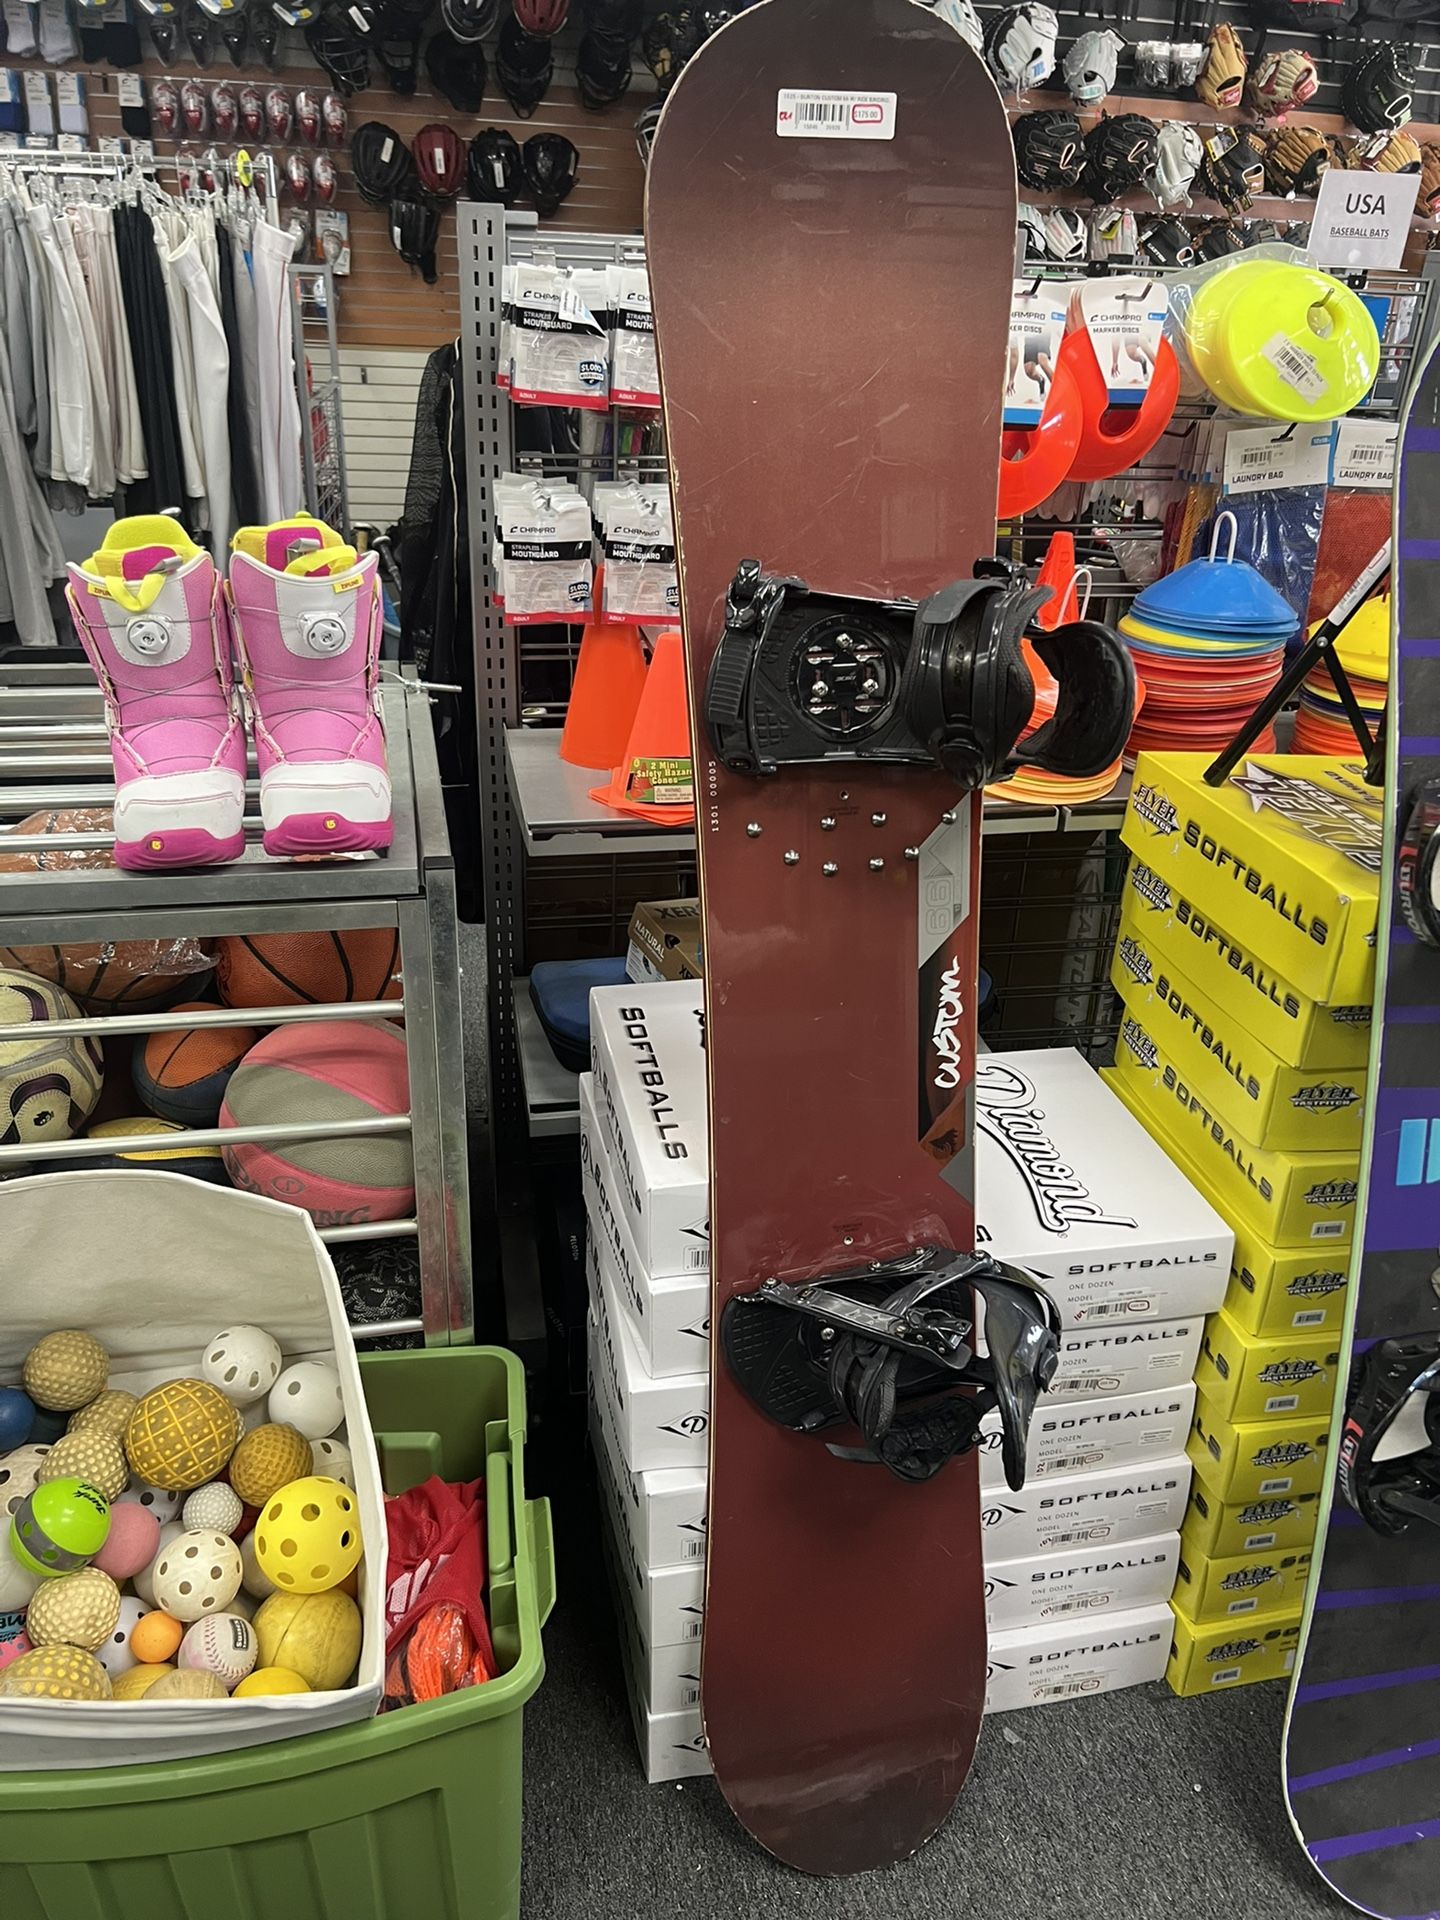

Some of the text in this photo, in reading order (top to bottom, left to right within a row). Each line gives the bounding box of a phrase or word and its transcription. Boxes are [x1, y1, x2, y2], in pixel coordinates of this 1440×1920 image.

[1345, 193, 1385, 215] USA
[1330, 227, 1389, 238] BASEBALL BATS
[1146, 243, 1167, 263] EASTON
[523, 311, 552, 320] STRAPLESS
[1011, 312, 1046, 321] HAMPRO
[1100, 314, 1142, 322] CHAMPRO
[523, 318, 573, 330] MOUTHGUARD
[626, 320, 654, 329] MOUTH
[1024, 325, 1043, 334] DISCS
[1121, 326, 1140, 334] DISCS
[581, 363, 602, 372] $1,000
[519, 392, 537, 400] ADULT
[1232, 471, 1284, 484] LAUNDRY BAG
[1339, 471, 1393, 480] LAUNDRY BAG
[520, 526, 556, 534] CHAMPRO
[623, 527, 660, 537] CHAMPRO
[511, 550, 560, 559] MOUTHGUARD
[613, 544, 643, 552] STRAPLESS
[612, 550, 661, 560] MOUTHGUARD
[570, 583, 589, 593] $1,000
[659, 761, 679, 769] Mini
[636, 768, 692, 779] Safety Hazar
[651, 777, 678, 785] Cones
[708, 760, 720, 832] 1301 00005
[1136, 783, 1177, 821] FLYER
[1133, 801, 1171, 834] FASTPITCH
[1134, 863, 1172, 900] FLYER
[1182, 819, 1329, 946] SOFTBALLS
[1132, 878, 1166, 910] FASTPITCH
[654, 905, 700, 919] XER
[634, 919, 665, 960] NATURAL
[1122, 934, 1153, 971] FLYER
[1174, 899, 1300, 1020] SOFTBALLS
[1119, 950, 1148, 985] FASTPITCH
[932, 955, 964, 1089] CUSTOM
[1126, 1017, 1158, 1060] FLYER
[1155, 974, 1261, 1101] SOFTBALLS
[1122, 1031, 1153, 1070] FASTPITCH
[619, 1006, 689, 1160] SOFTBALLS
[1299, 1085, 1354, 1101] FLYER
[1291, 1098, 1351, 1108] FASTPITCH
[1161, 1067, 1274, 1202] SOFTBALLS
[603, 1071, 643, 1215] SOFTBALLS
[594, 1163, 644, 1317] SOFTBALLS
[1068, 1253, 1218, 1276] SOFTBALLS
[1068, 1280, 1115, 1291] ONE DOZEN
[1293, 1272, 1346, 1288] FLYER
[1287, 1283, 1342, 1296] FASTPITCH
[1067, 1295, 1093, 1303] MODEL
[593, 1246, 625, 1410] SOFTBALLS
[1056, 1328, 1190, 1353] OFTBALLS
[1062, 1358, 1088, 1367] DOZEN
[1264, 1359, 1317, 1375] FLYER
[1259, 1373, 1314, 1384] FASTPITCH
[1042, 1403, 1181, 1432] SOFTBALLS
[1040, 1434, 1082, 1446] ONE DOZEN
[1038, 1449, 1063, 1457] MODEL
[1259, 1442, 1308, 1458] FLYER
[1251, 1453, 1305, 1466] FASTPITCH
[1040, 1480, 1177, 1509] SOFTBALLS
[1242, 1500, 1291, 1516] FLYER
[1037, 1511, 1079, 1522] ONE DOZEN
[1238, 1512, 1288, 1525] FASTPITCH
[1036, 1525, 1060, 1533] MODEL
[1031, 1554, 1167, 1582] SOFTBALLS
[1224, 1566, 1273, 1583] FLYER
[1220, 1576, 1271, 1590] FASTPITCH
[1031, 1584, 1074, 1596] ONE DOZEN
[1031, 1598, 1054, 1606] MODEL
[1029, 1633, 1161, 1665] SOFTBALLS
[1209, 1638, 1257, 1657] FLYER
[1205, 1648, 1255, 1663] FASTPITCH
[1029, 1664, 1070, 1677] ONE DOZEN
[1028, 1678, 1051, 1686] MODEL
